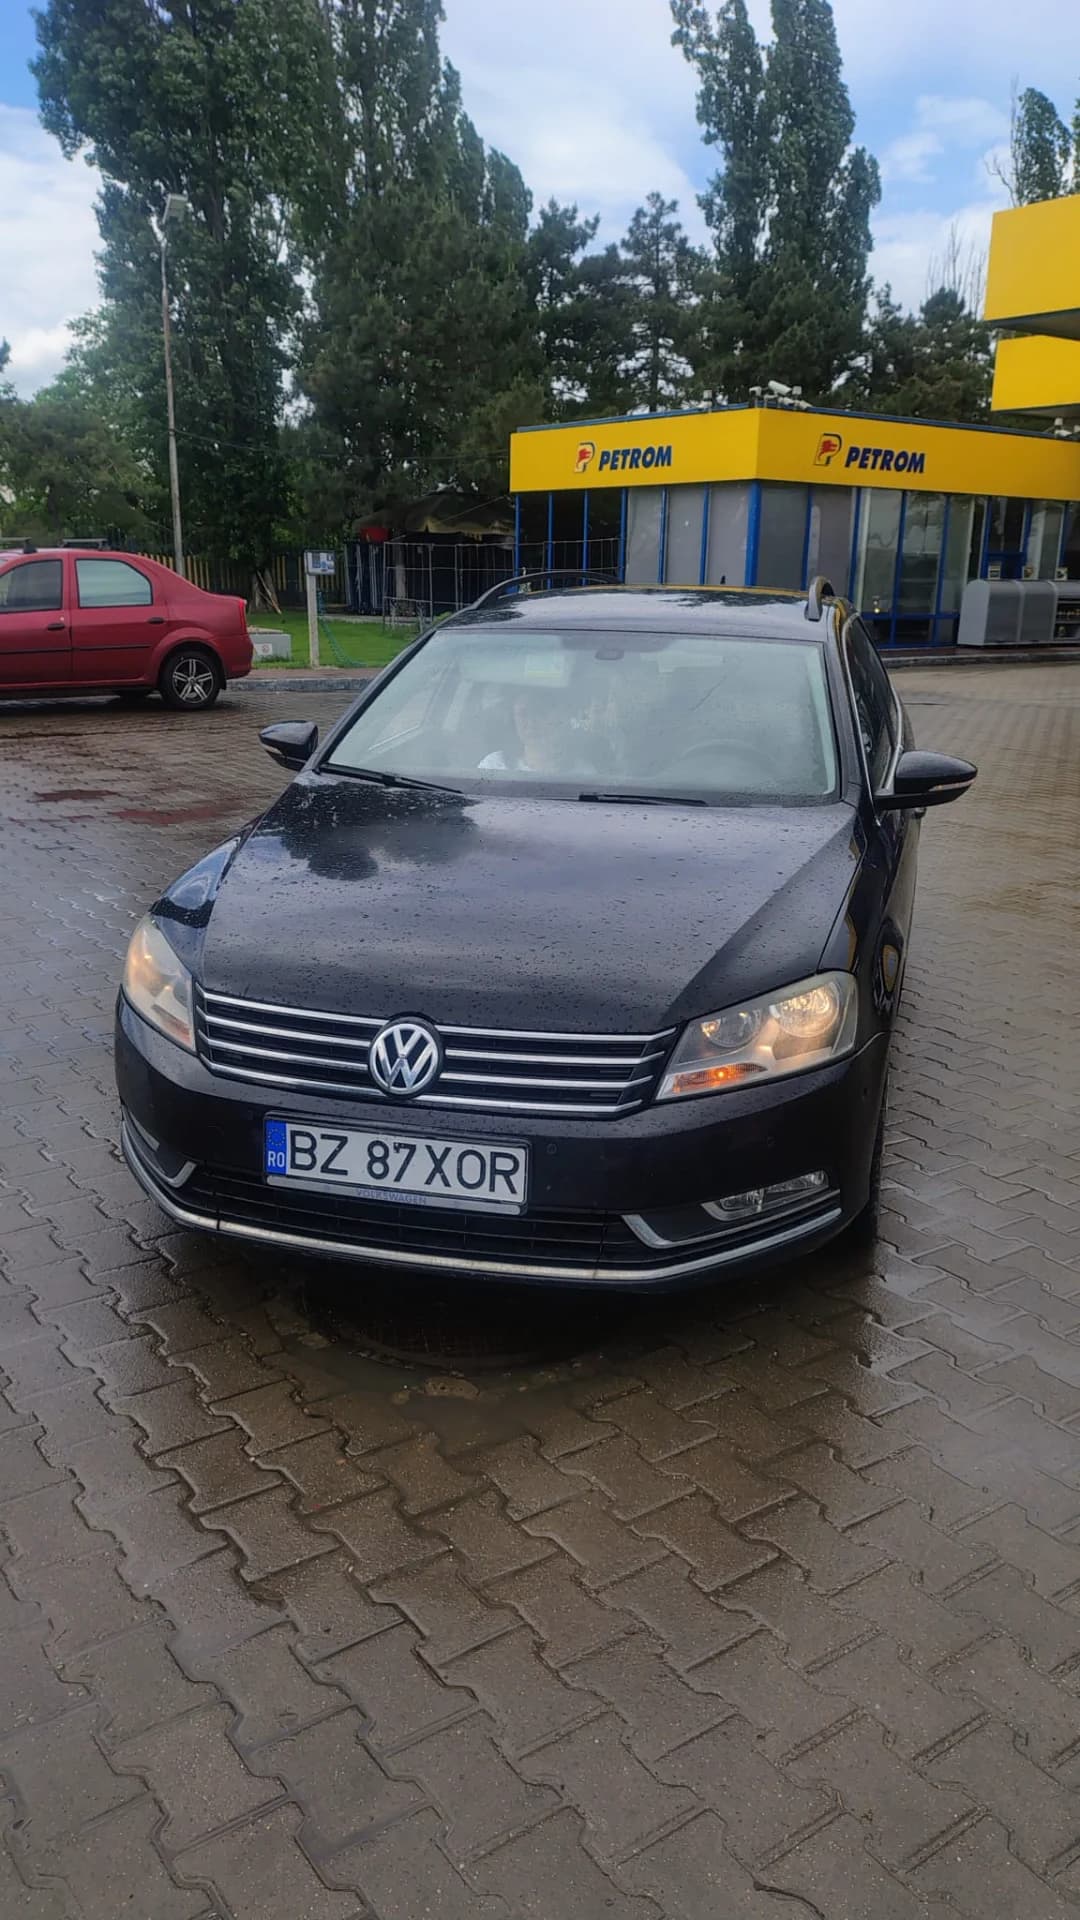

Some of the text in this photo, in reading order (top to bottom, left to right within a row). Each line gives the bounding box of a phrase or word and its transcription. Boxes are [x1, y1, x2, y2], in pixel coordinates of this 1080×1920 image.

[598, 445, 672, 472] PETROM
[844, 446, 925, 474] PETROM
[267, 1150, 286, 1168] RO
[289, 1129, 349, 1176] BZ
[355, 1187, 427, 1206] VOLKSWAGEN
